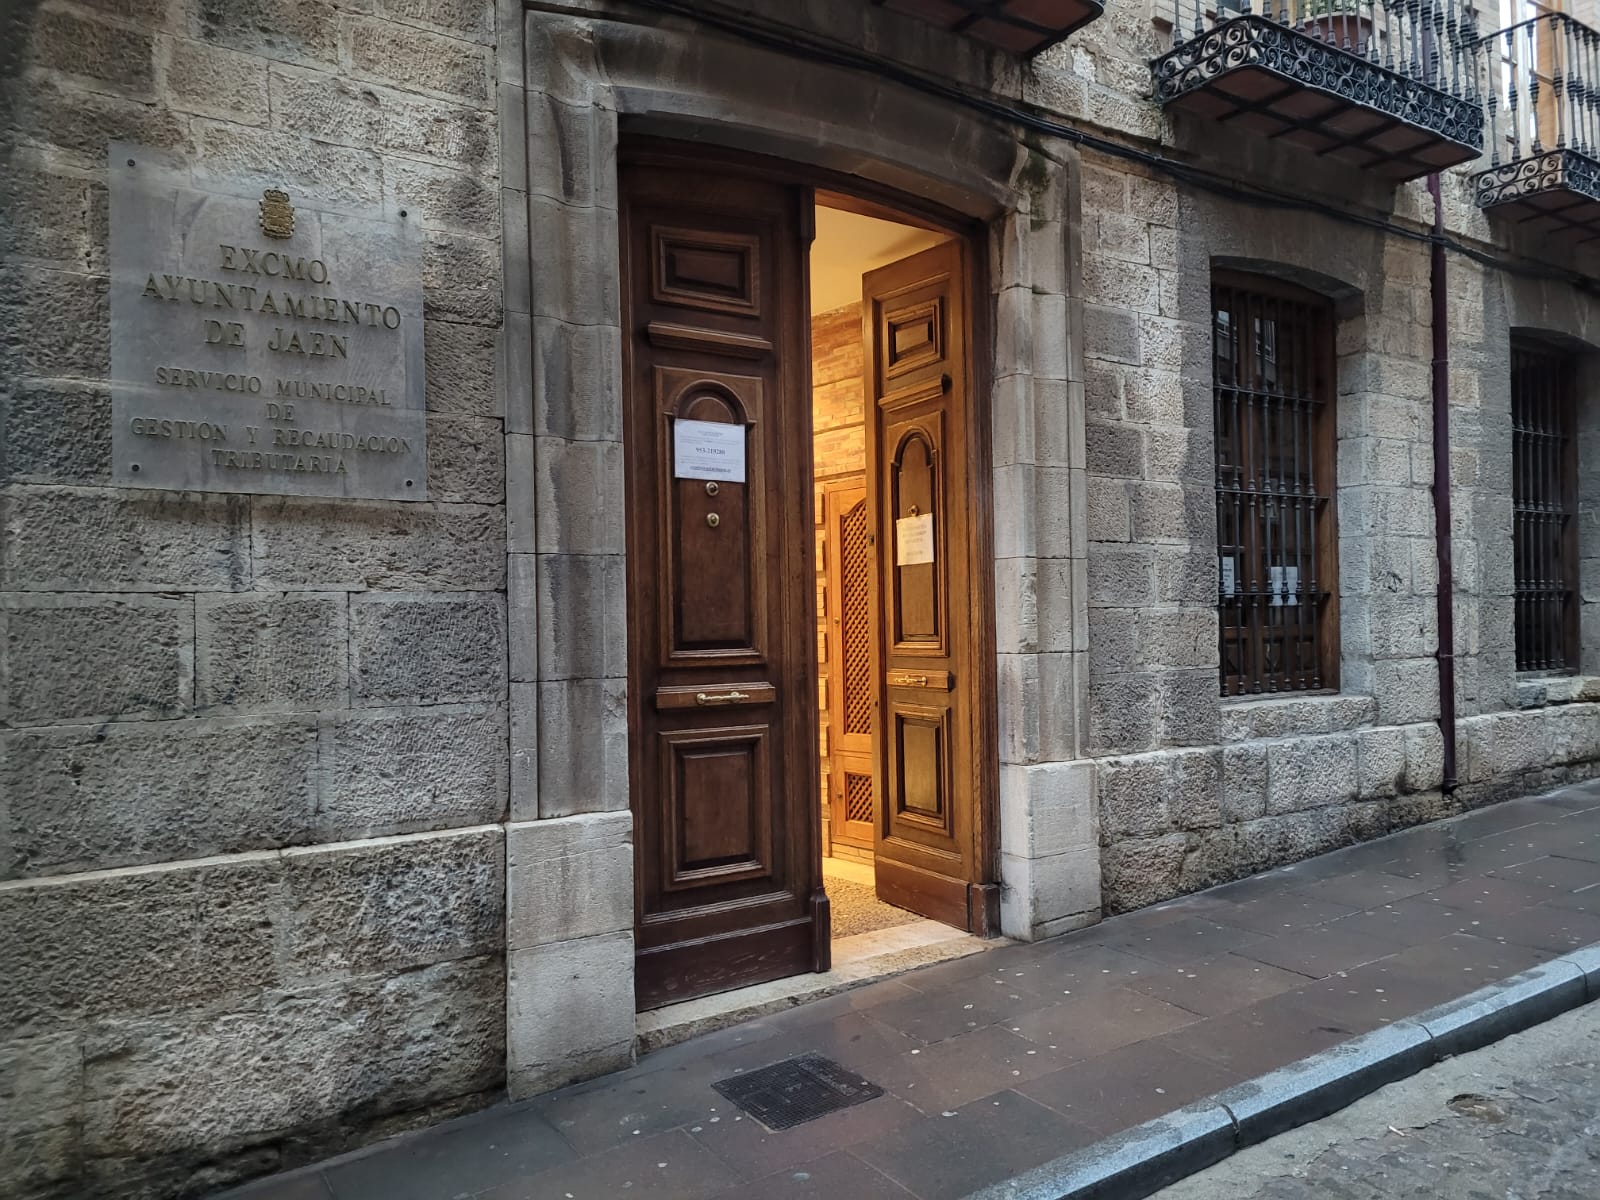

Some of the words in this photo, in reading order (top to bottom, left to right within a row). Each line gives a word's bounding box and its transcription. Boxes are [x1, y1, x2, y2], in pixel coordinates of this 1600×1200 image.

[219, 244, 331, 284] EXCMO.
[142, 272, 401, 329] AYUNTAMIENTO
[204, 319, 245, 347] DE
[267, 327, 349, 359] JAEN
[156, 366, 262, 394] SERVICIO
[276, 378, 391, 406] MUNICIPAL
[265, 403, 295, 422] DE
[244, 426, 258, 445] Y
[272, 427, 413, 454] RECAUDACION
[211, 448, 349, 474] TRIBUTARIA
